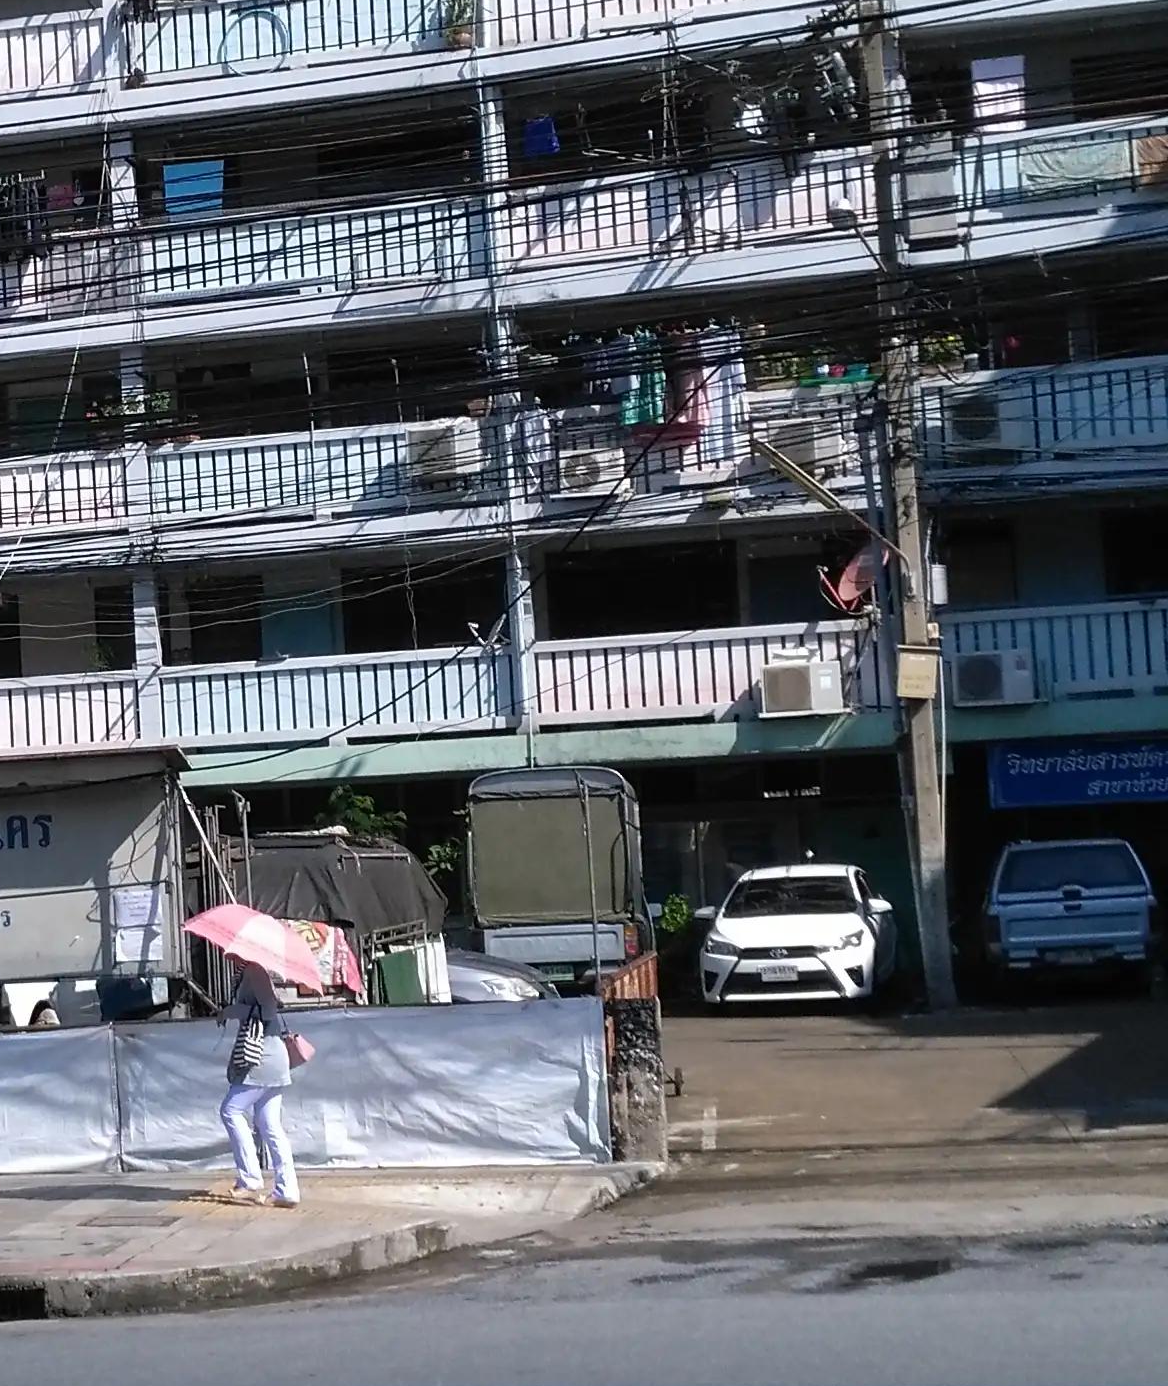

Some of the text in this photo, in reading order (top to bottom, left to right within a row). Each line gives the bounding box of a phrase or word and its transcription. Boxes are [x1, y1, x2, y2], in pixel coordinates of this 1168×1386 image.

[1007, 744, 1168, 775] วิทยาลัยสารพัด
